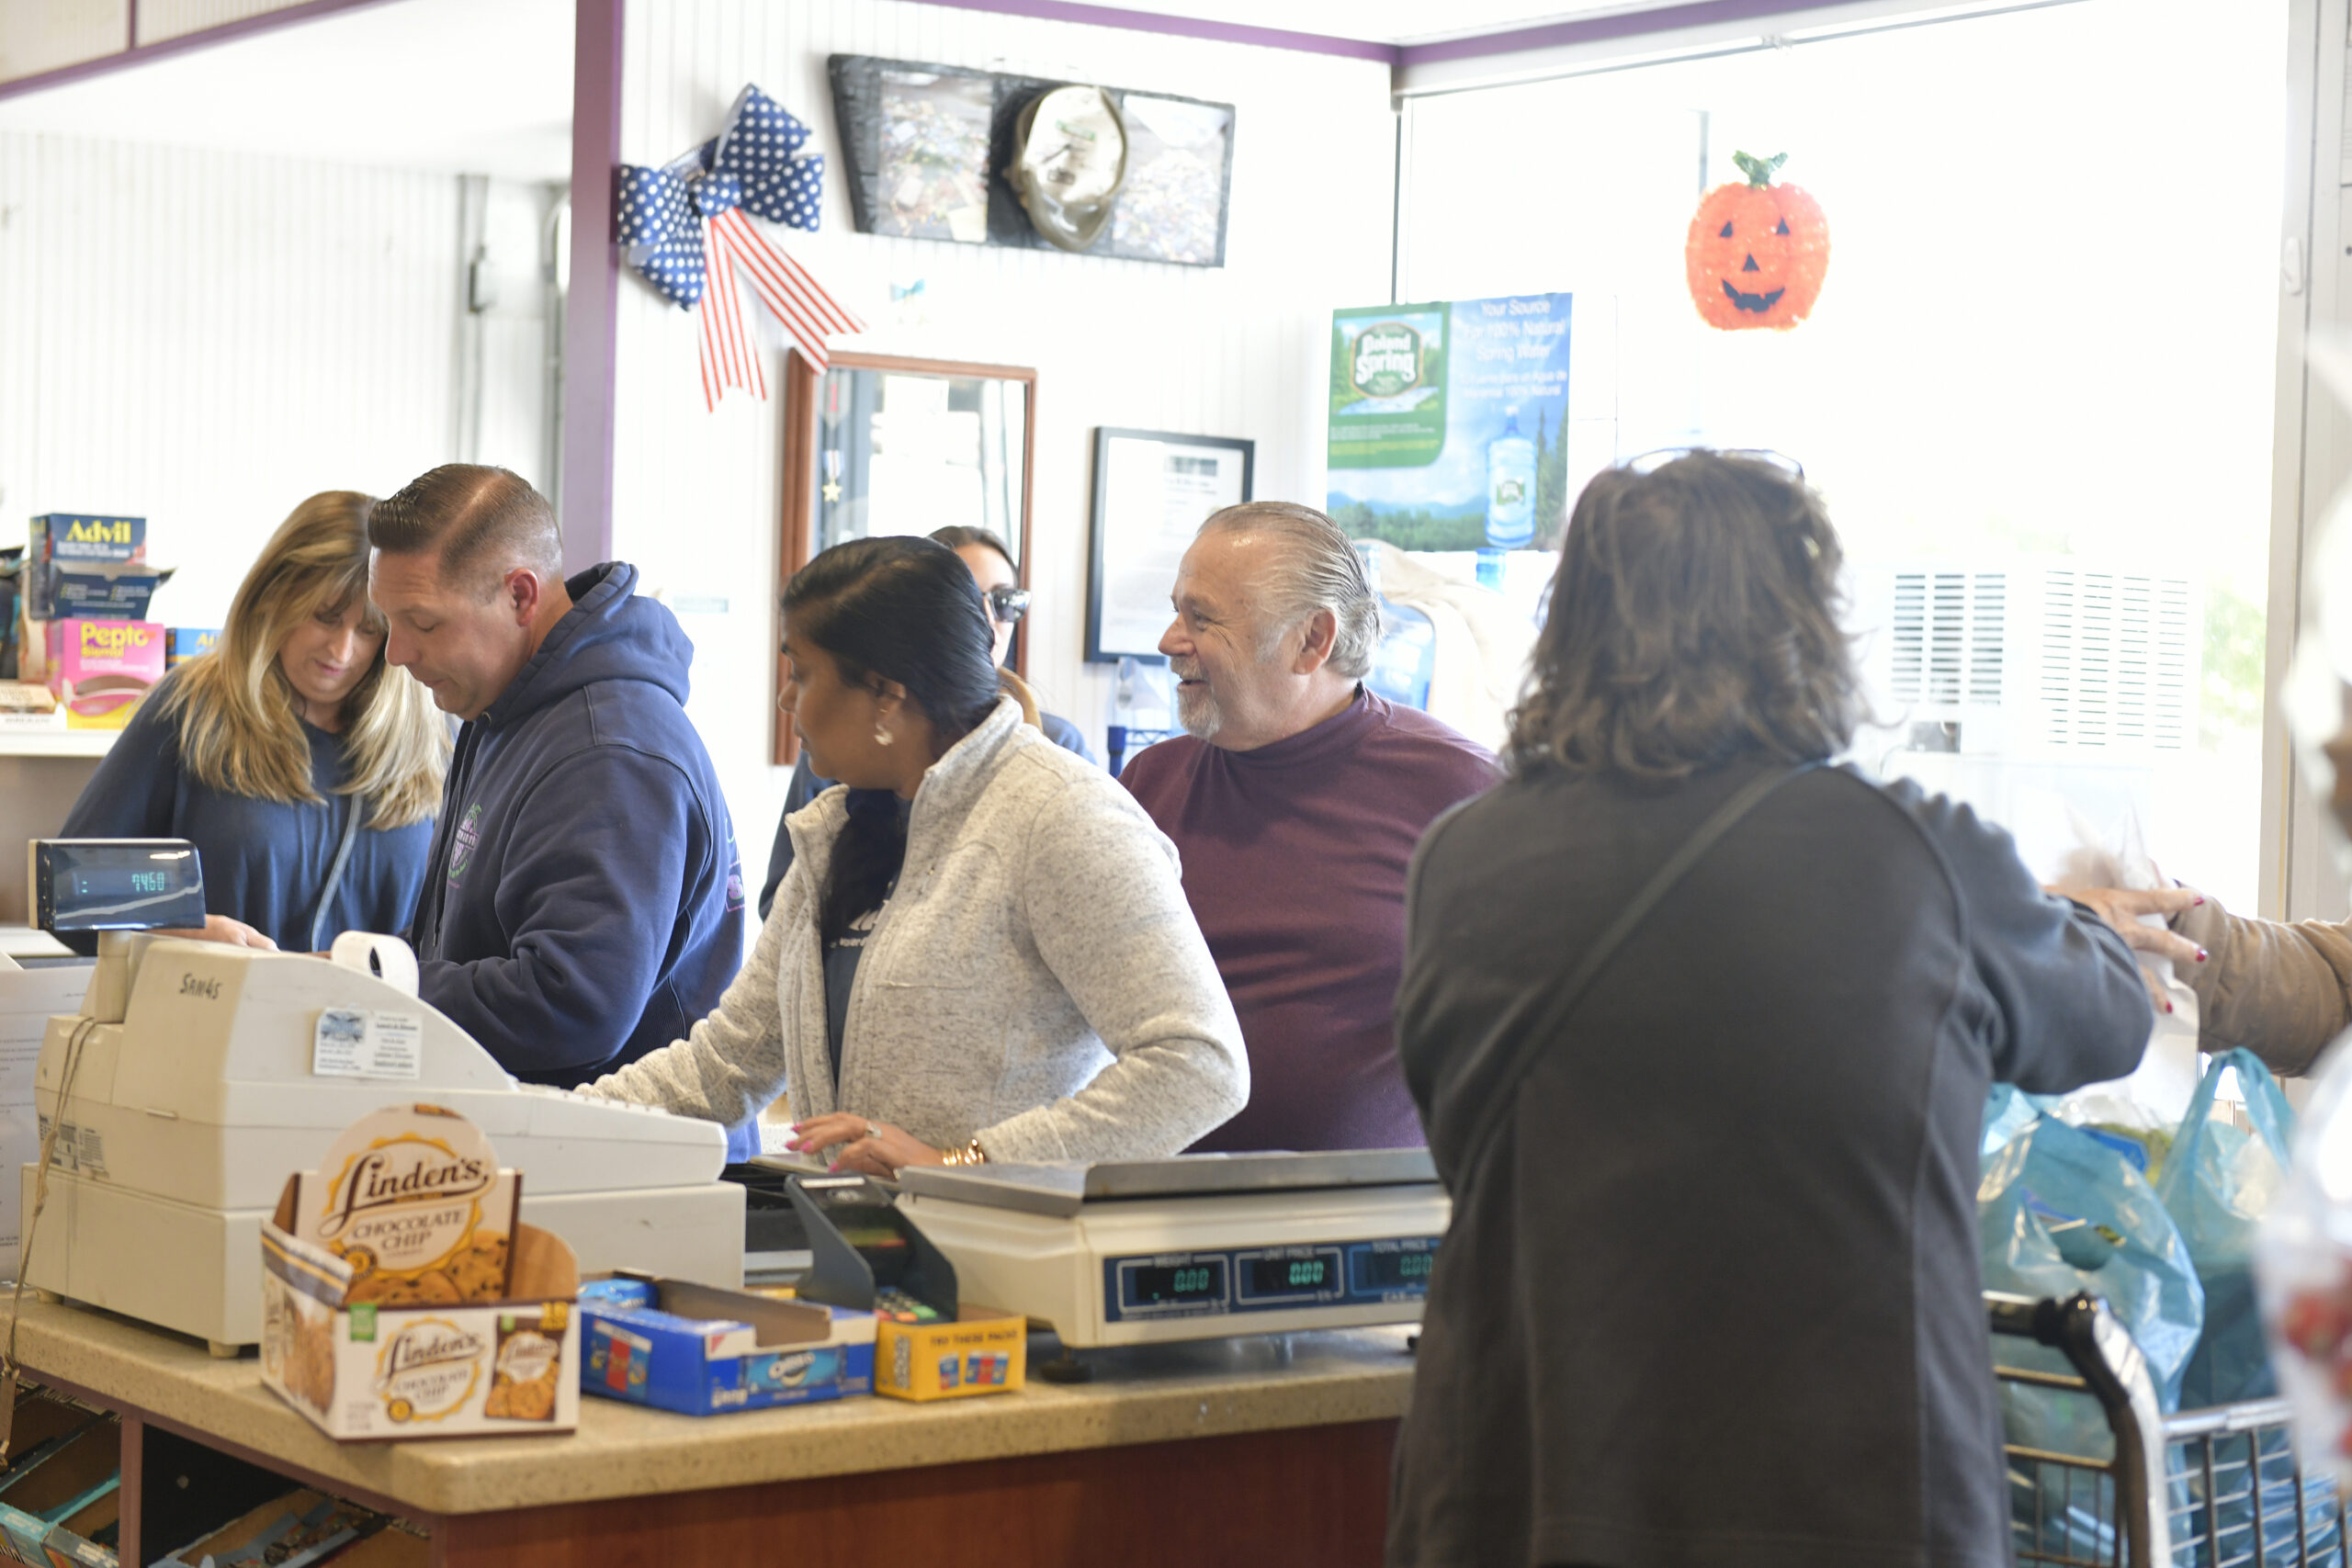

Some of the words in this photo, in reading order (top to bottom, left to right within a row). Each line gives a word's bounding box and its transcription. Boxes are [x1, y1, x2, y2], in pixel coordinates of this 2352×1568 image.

[1482, 300, 1506, 317] Your
[1509, 299, 1550, 315] Source
[1523, 318, 1566, 336] Natural
[1476, 344, 1515, 363] Spring
[1516, 343, 1551, 359] Water
[1355, 349, 1416, 385] Spring
[66, 519, 131, 544] Advil
[81, 621, 150, 649] Pepto
[319, 1153, 489, 1238] Linden's
[353, 1209, 466, 1239] CHOCOLATE
[381, 1230, 433, 1250] CHIP
